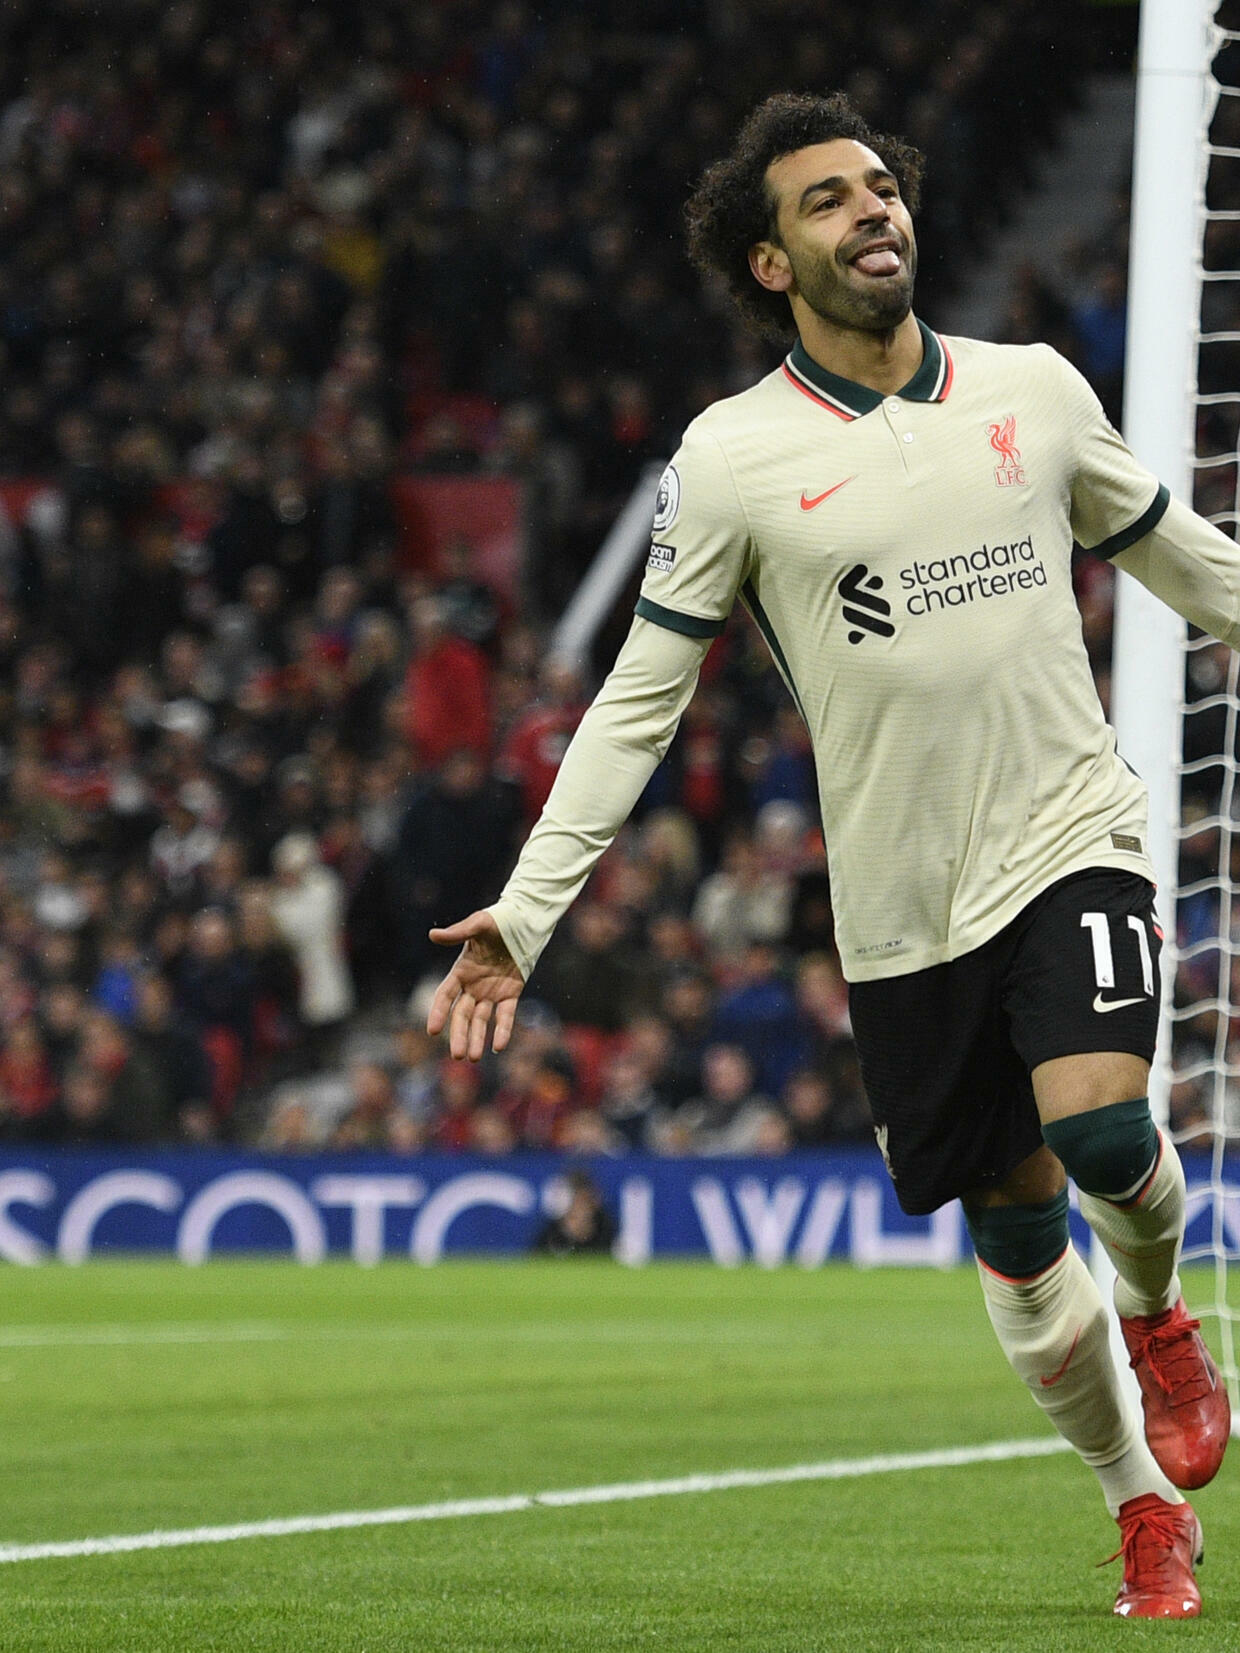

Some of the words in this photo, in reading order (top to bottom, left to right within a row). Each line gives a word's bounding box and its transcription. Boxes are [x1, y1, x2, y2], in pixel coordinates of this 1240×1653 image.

[899, 534, 1035, 590] standard
[906, 560, 1048, 616] chartered
[1080, 911, 1155, 998] 11
